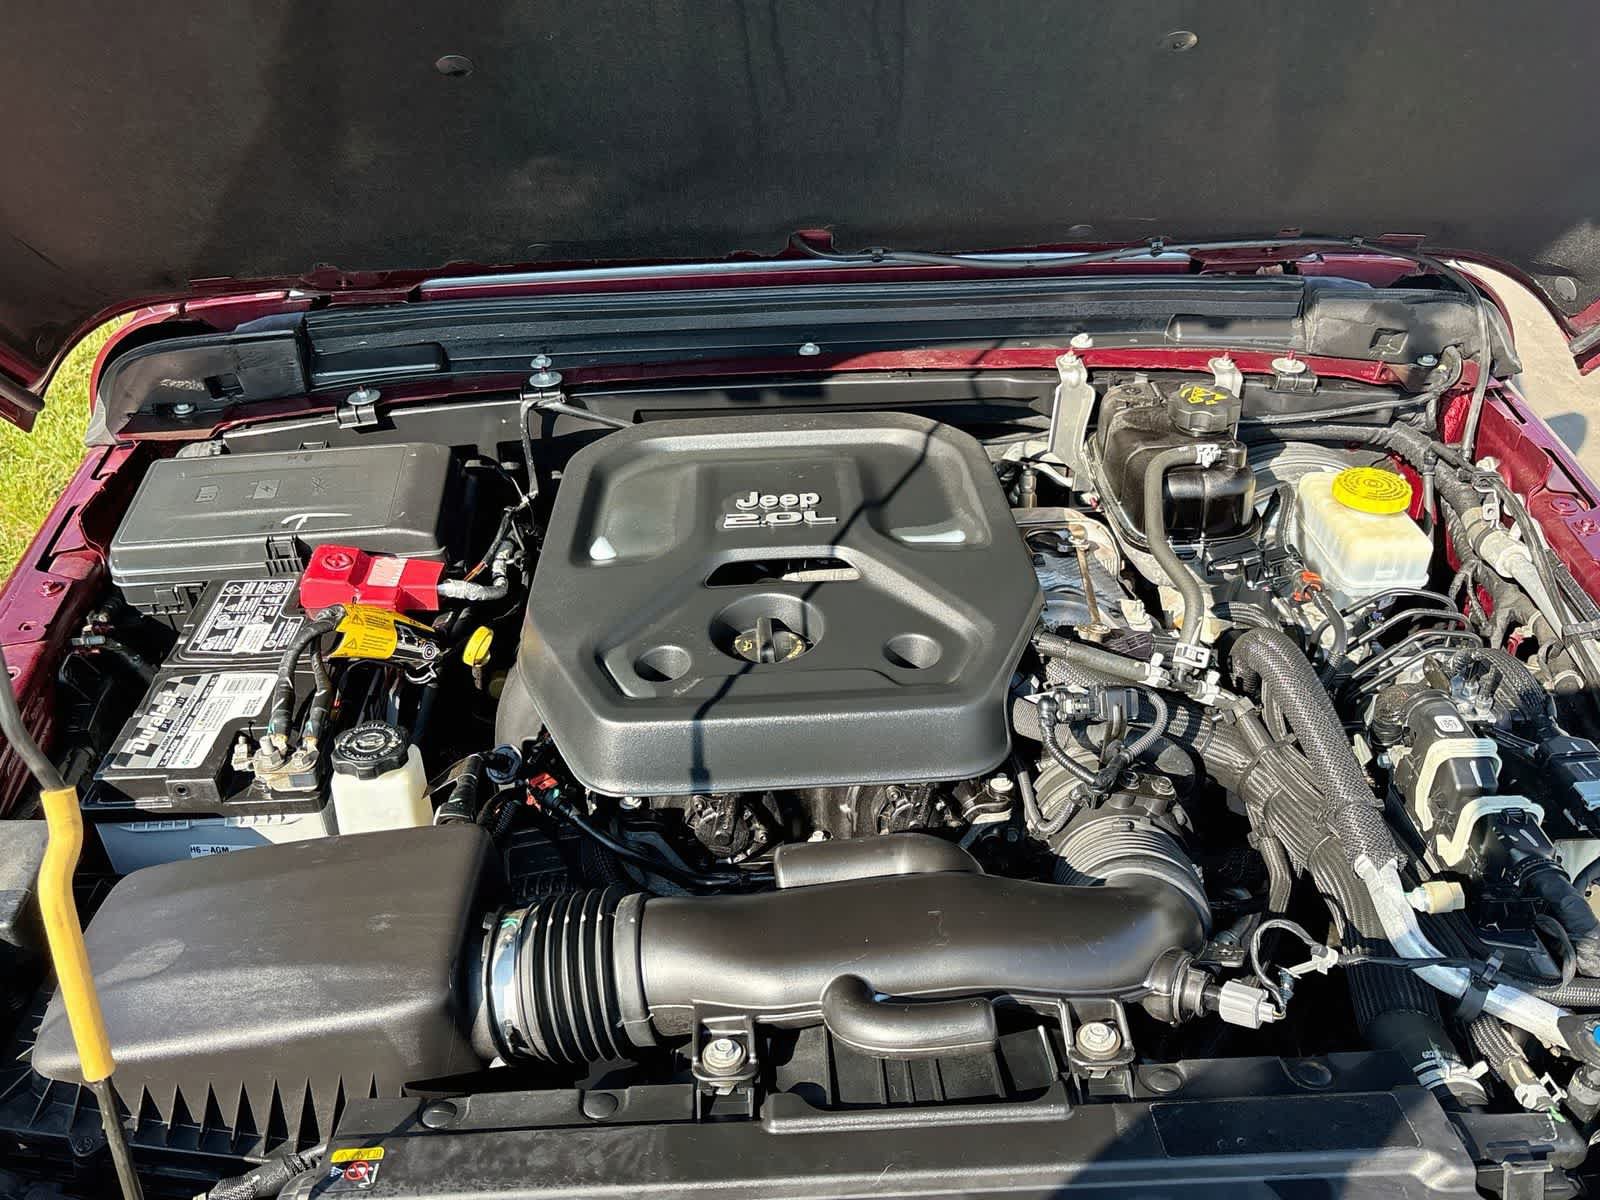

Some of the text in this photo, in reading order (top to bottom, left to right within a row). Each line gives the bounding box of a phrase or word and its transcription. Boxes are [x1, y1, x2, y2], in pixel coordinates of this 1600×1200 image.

[736, 491, 821, 510] Jeep
[723, 511, 838, 528] 2.0L
[123, 689, 179, 752] Duralast
